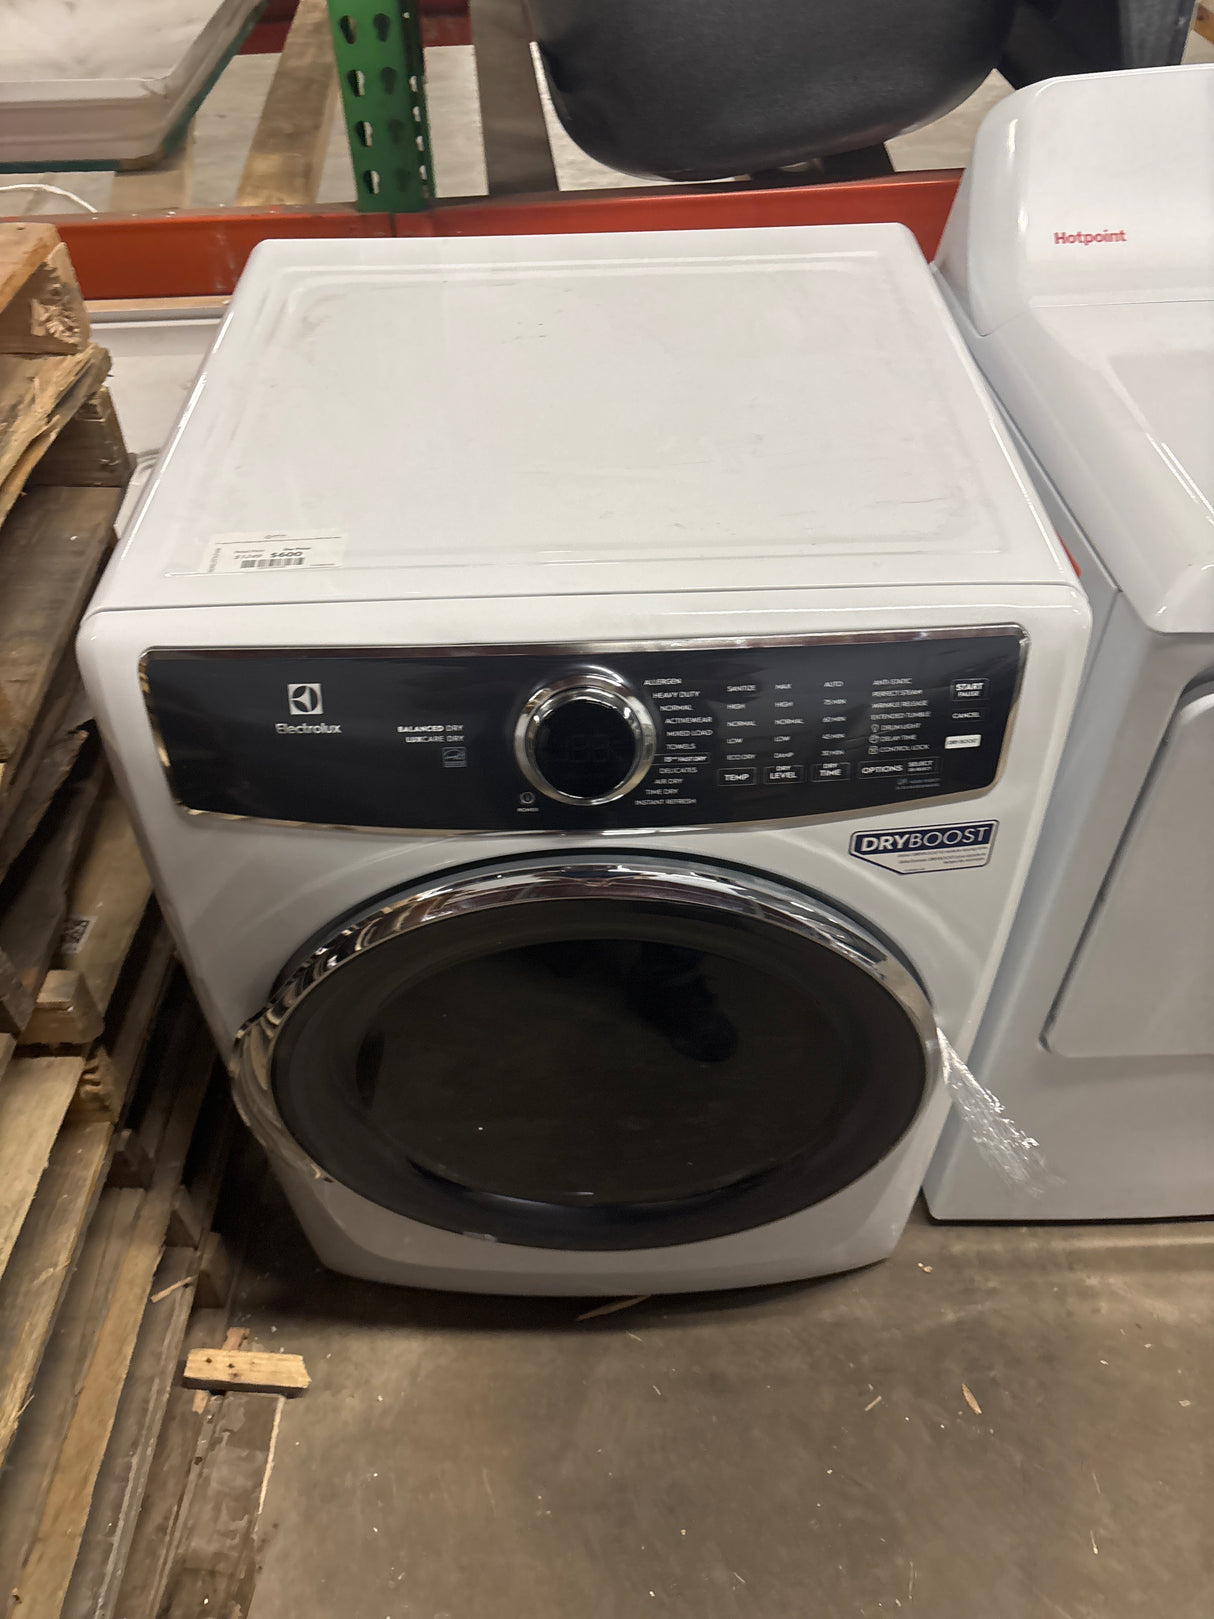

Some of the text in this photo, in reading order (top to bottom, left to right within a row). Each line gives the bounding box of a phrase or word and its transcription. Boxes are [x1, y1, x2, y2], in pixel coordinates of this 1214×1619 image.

[1054, 229, 1127, 245] Hotpoint
[643, 678, 682, 686] ALLERGEN
[956, 682, 984, 691] START
[652, 690, 701, 699] HEAVY DUTY
[660, 704, 693, 712] NORMAL
[870, 710, 932, 720] EXTENDED TUMBLE
[952, 711, 980, 719] CANCEL
[665, 716, 713, 724] ACTIVEWEAR
[274, 722, 343, 735] Electrolux
[397, 724, 464, 733] BALANCED DRY
[659, 766, 698, 774] DELICATES
[861, 765, 904, 774] OPTIONS
[724, 773, 750, 781] TEMP
[769, 771, 797, 779] LEVEL
[861, 827, 989, 851] DRYBOOST
